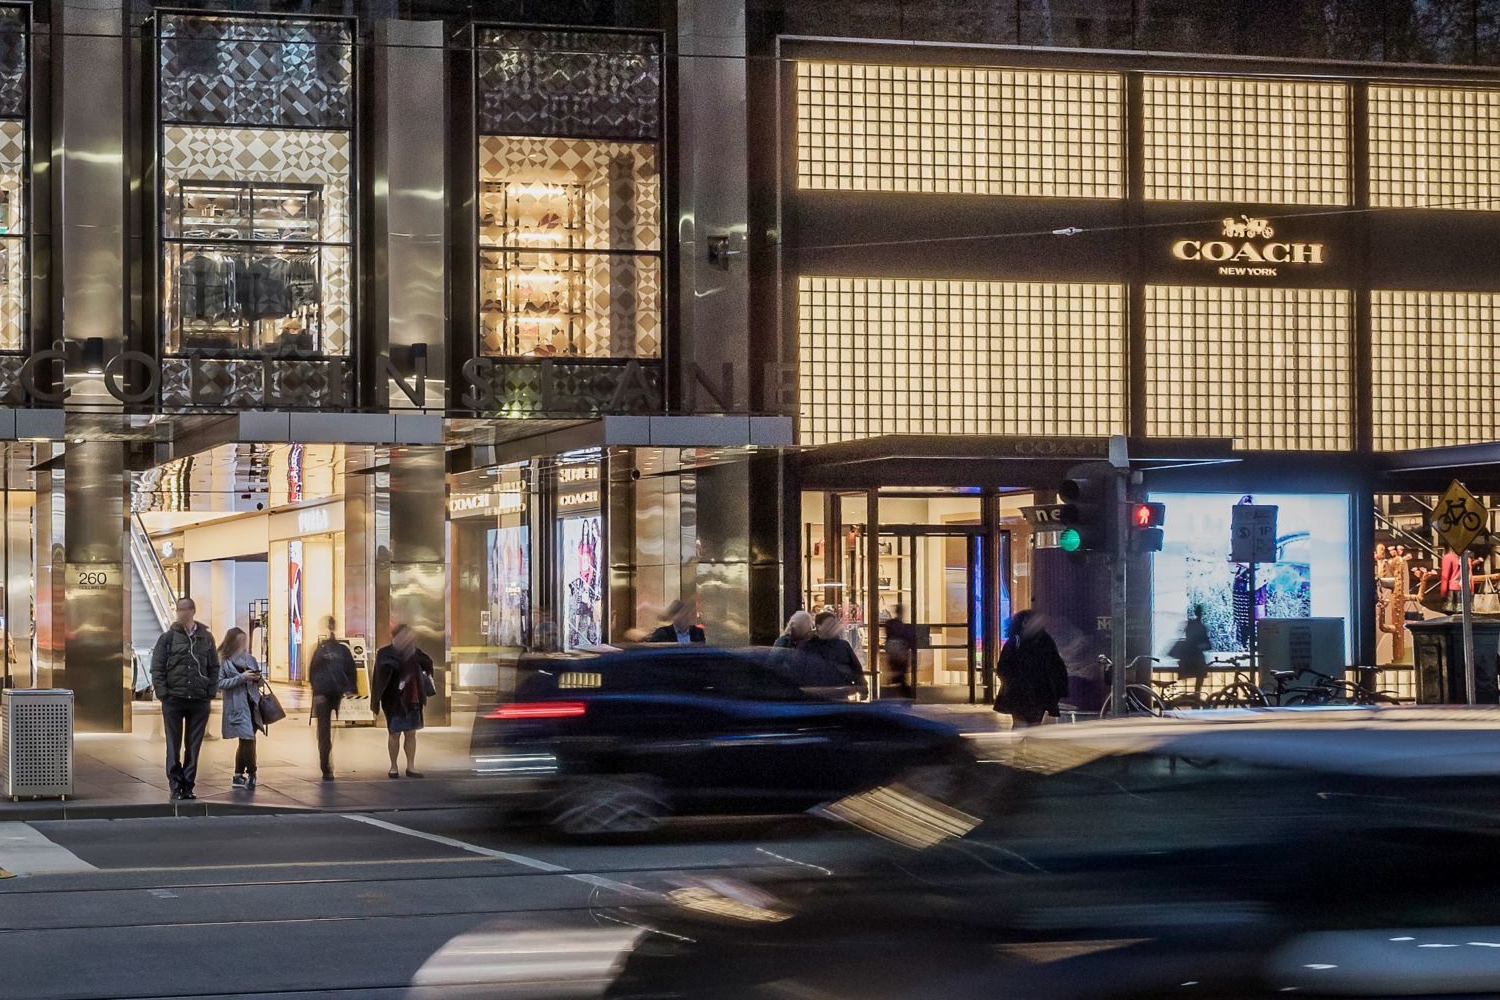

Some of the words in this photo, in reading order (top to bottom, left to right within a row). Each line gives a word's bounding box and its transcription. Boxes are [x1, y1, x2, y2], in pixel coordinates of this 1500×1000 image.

[1173, 240, 1324, 264] COACH
[1219, 266, 1245, 276] NEW
[1248, 267, 1277, 276] YORK
[21, 349, 494, 409] COLLINS
[541, 357, 798, 412] LANE
[560, 490, 598, 506] COACH
[79, 572, 107, 585] 260
